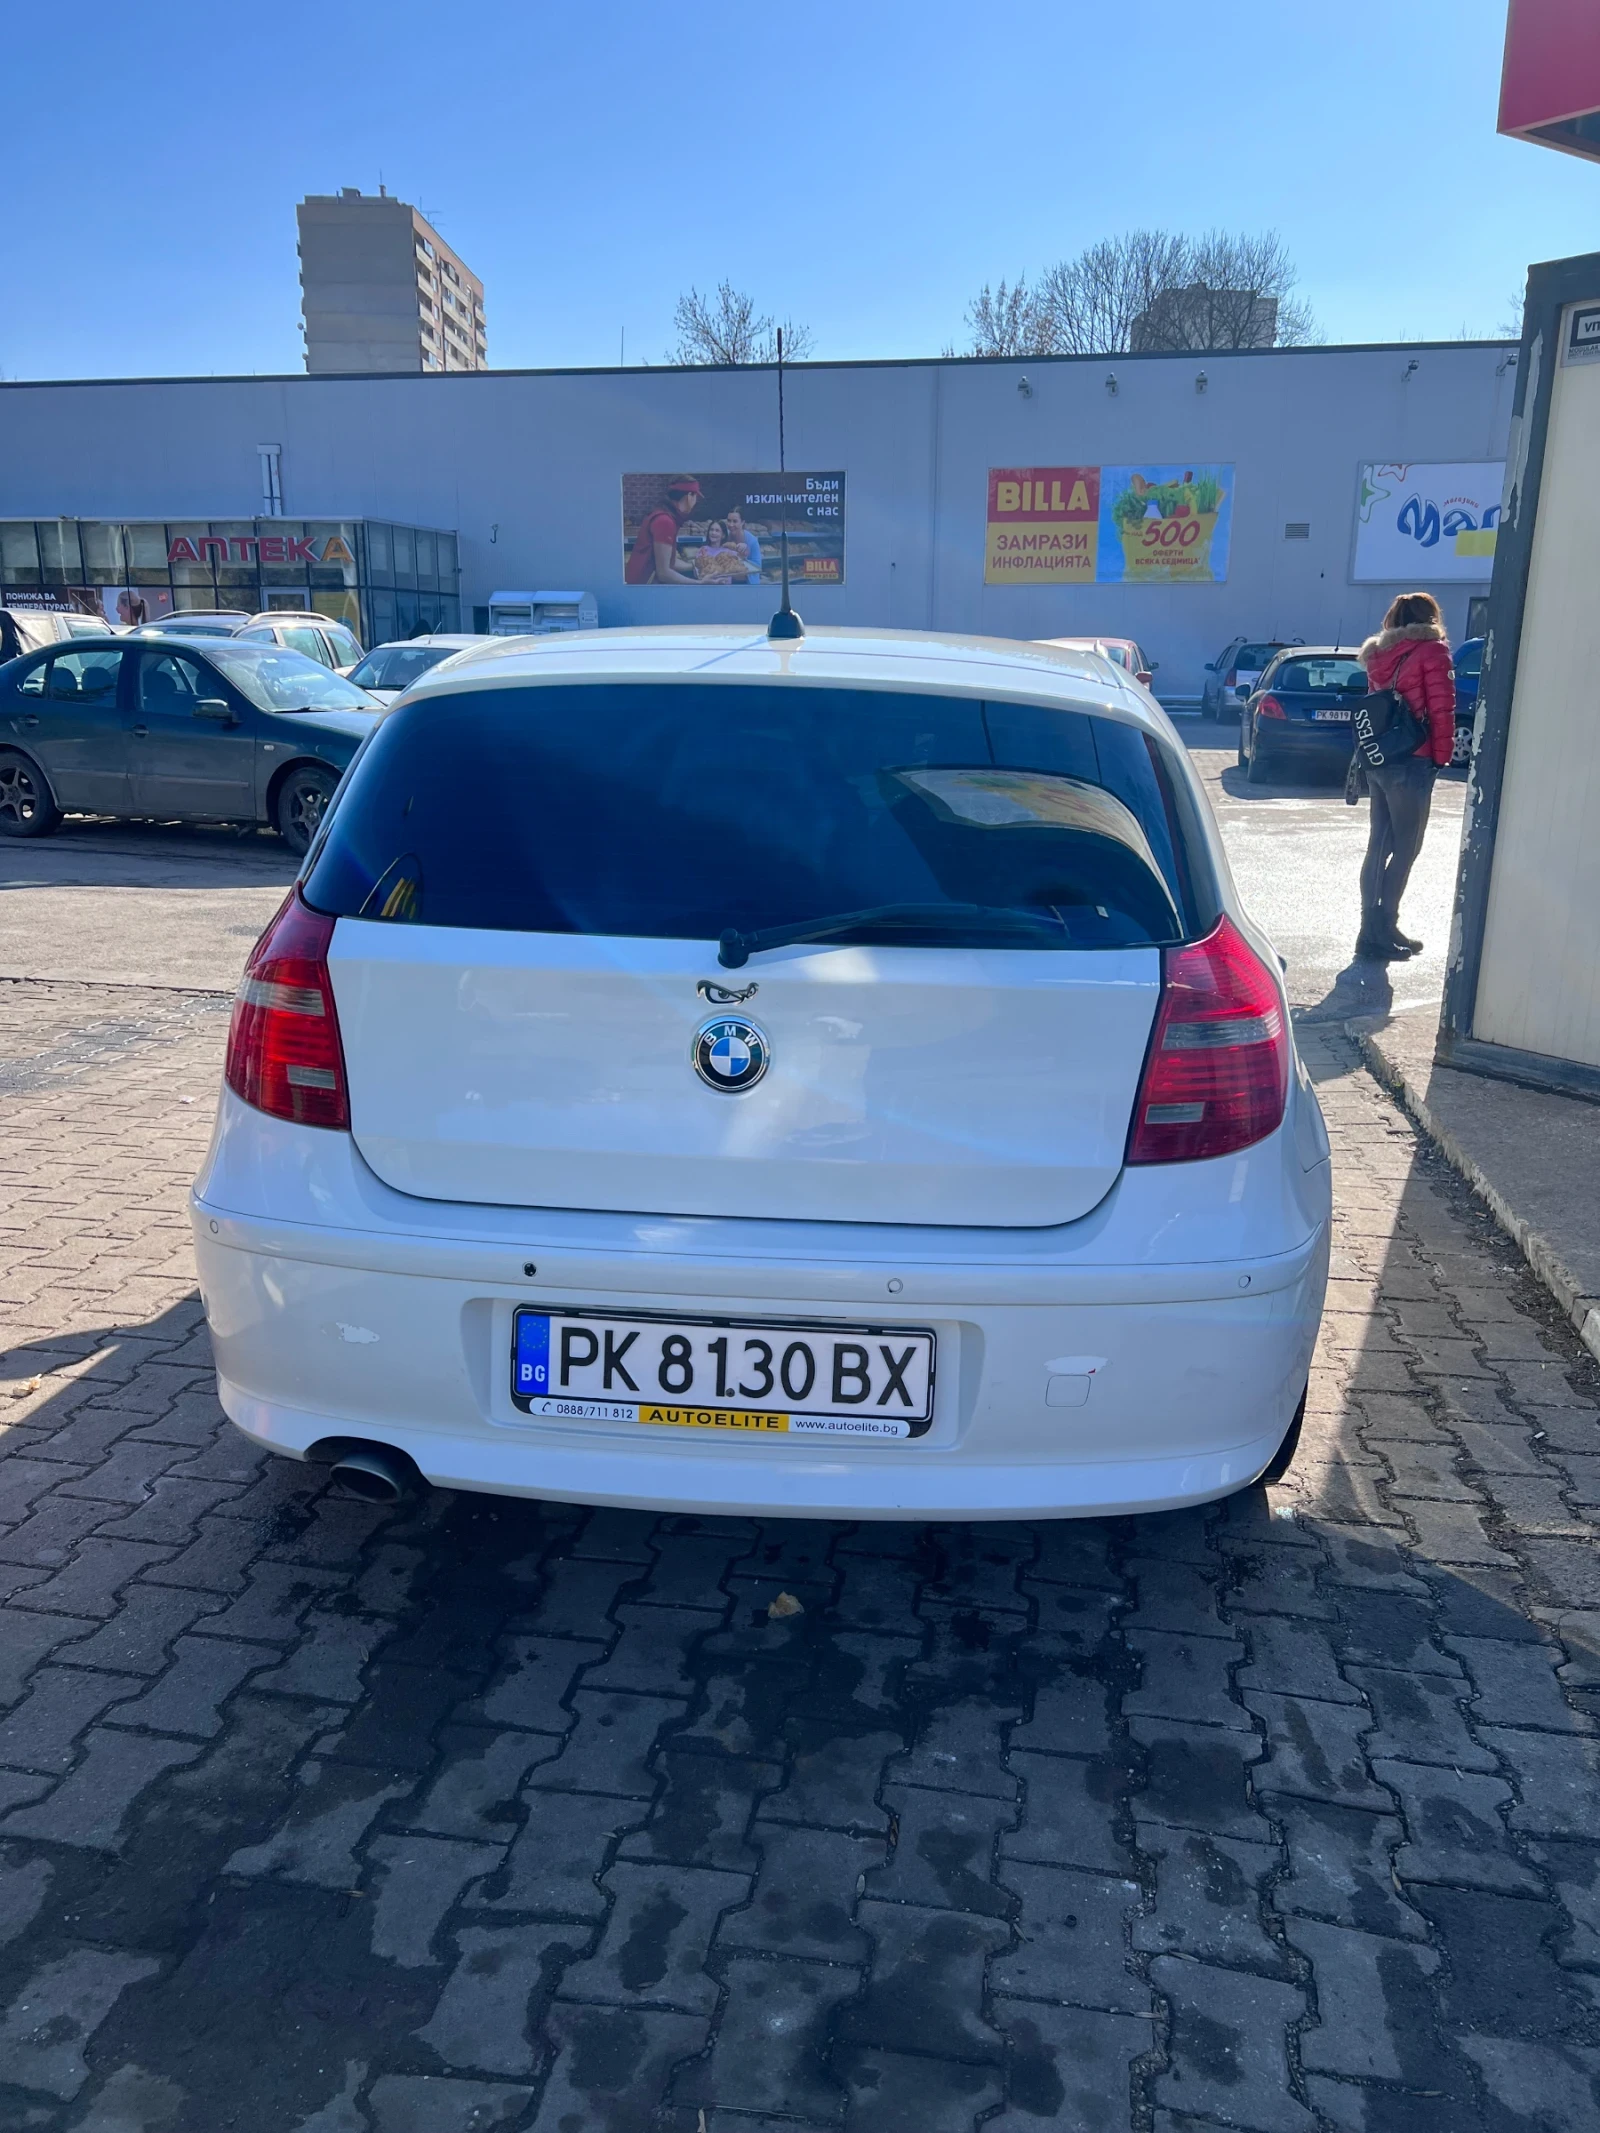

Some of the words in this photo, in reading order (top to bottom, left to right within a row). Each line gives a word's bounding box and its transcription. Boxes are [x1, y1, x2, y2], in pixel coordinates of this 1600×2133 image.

[806, 478, 839, 491] Бъди
[997, 480, 1090, 511] BILLA
[807, 507, 813, 516] с
[817, 507, 839, 516] нас
[997, 534, 1088, 551] ЗАМРАЗИ
[1142, 520, 1200, 547] 500
[167, 536, 356, 563] АПТЕКА
[1153, 549, 1183, 557] ОФЕРТИ
[806, 560, 836, 572] BILLA
[992, 555, 1091, 571] ИНФЛАЦИЯТА
[1330, 711, 1349, 719] 9819
[1354, 709, 1385, 766] GUESS
[704, 1025, 758, 1047] BMW
[521, 1364, 545, 1382] BG
[560, 1327, 640, 1391] PK
[832, 1343, 917, 1407] BX
[612, 1409, 633, 1419] 812
[649, 1409, 780, 1429] AUTOELITE
[795, 1419, 898, 1435] www.autoelite.bg
